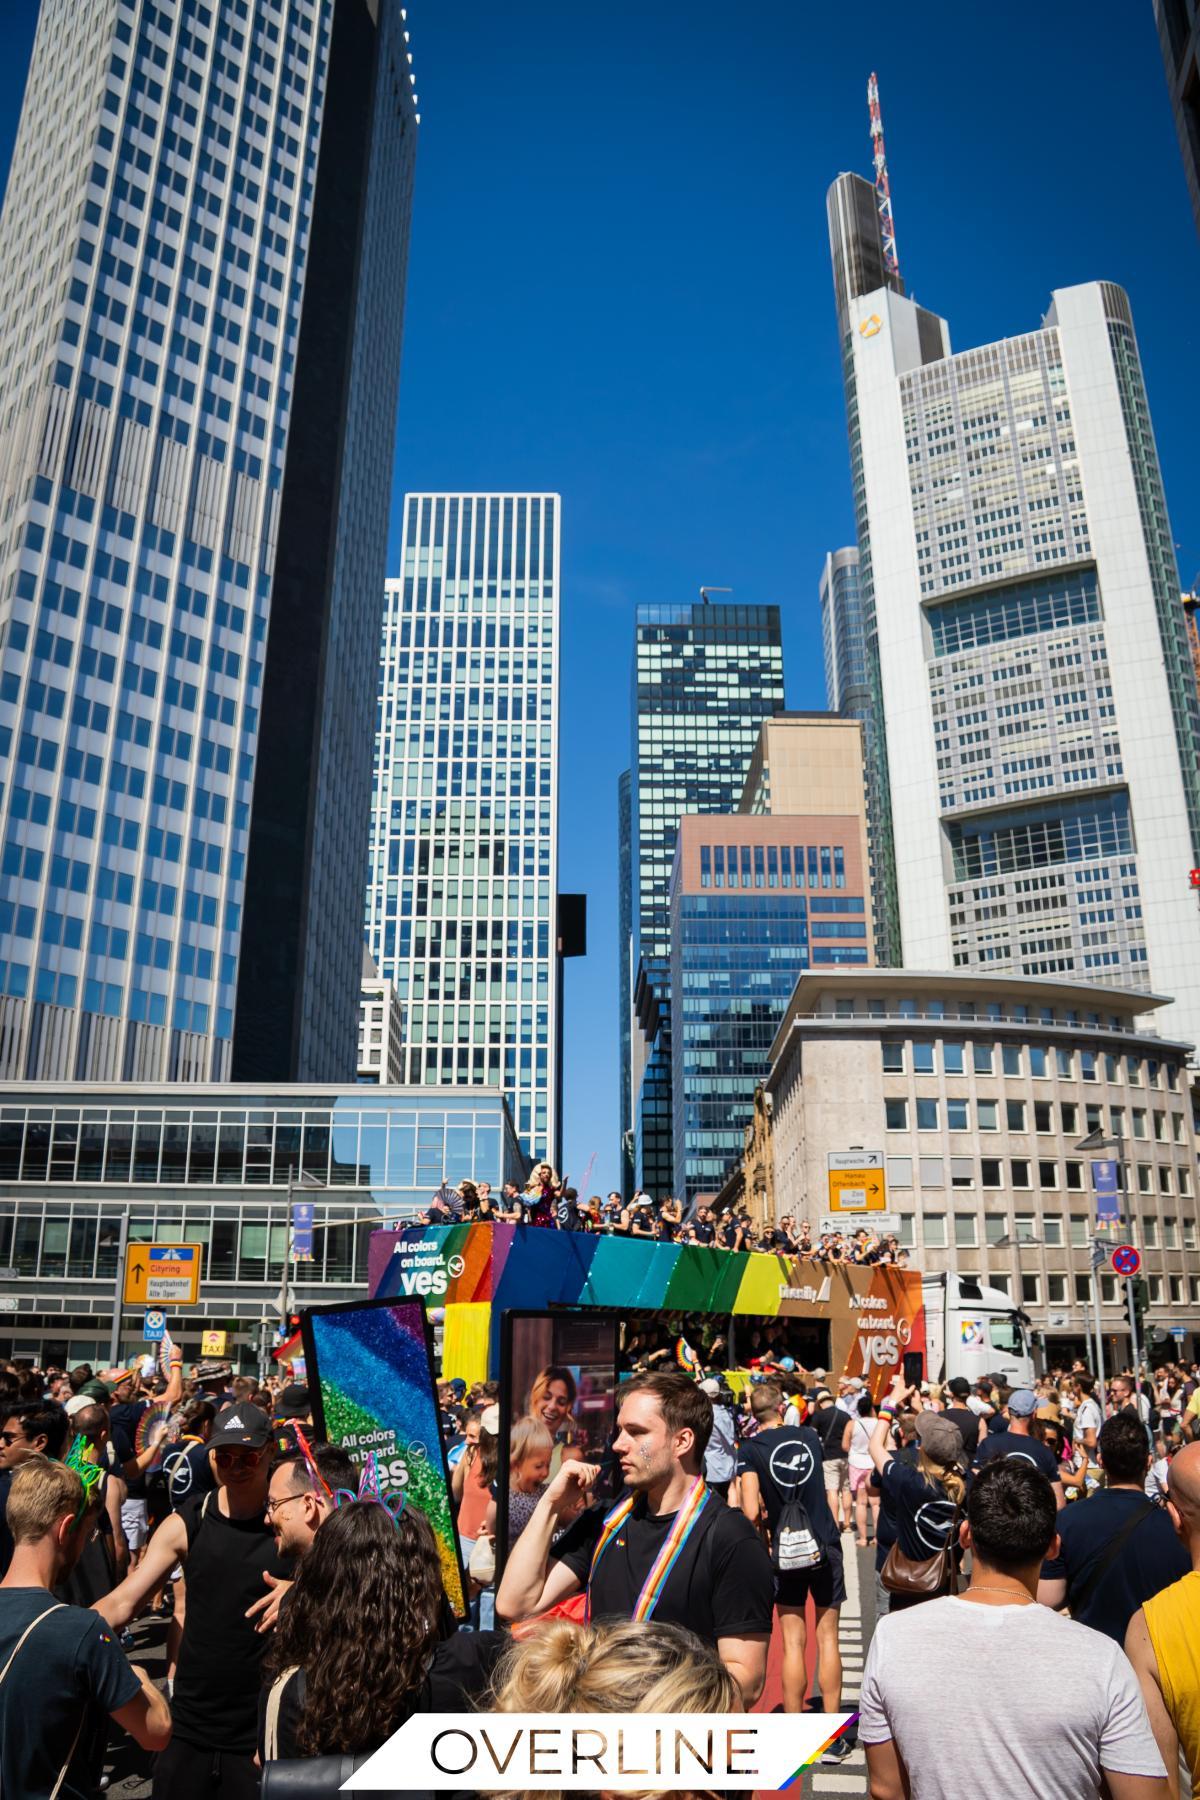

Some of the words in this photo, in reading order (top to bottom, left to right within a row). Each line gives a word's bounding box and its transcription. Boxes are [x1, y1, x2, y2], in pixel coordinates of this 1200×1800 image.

[394, 1241, 407, 1254] All
[408, 1240, 438, 1252] colors
[401, 1258, 414, 1268] on
[415, 1253, 446, 1267] board.
[150, 1264, 180, 1275] Cityring
[150, 1279, 189, 1289] Hauptbahnhof
[401, 1270, 448, 1296] yes
[149, 1290, 160, 1298] Alte
[162, 1289, 177, 1299] Oper
[849, 1294, 861, 1309] All
[861, 1295, 888, 1310] colors
[857, 1317, 869, 1330] on
[869, 1314, 896, 1330] board.
[146, 1329, 163, 1338] TAXI
[203, 1345, 223, 1353] TAXI
[859, 1336, 899, 1375] yes
[342, 1434, 357, 1448] All
[358, 1430, 396, 1445] colors
[348, 1453, 360, 1463] n
[360, 1443, 399, 1461] bard.
